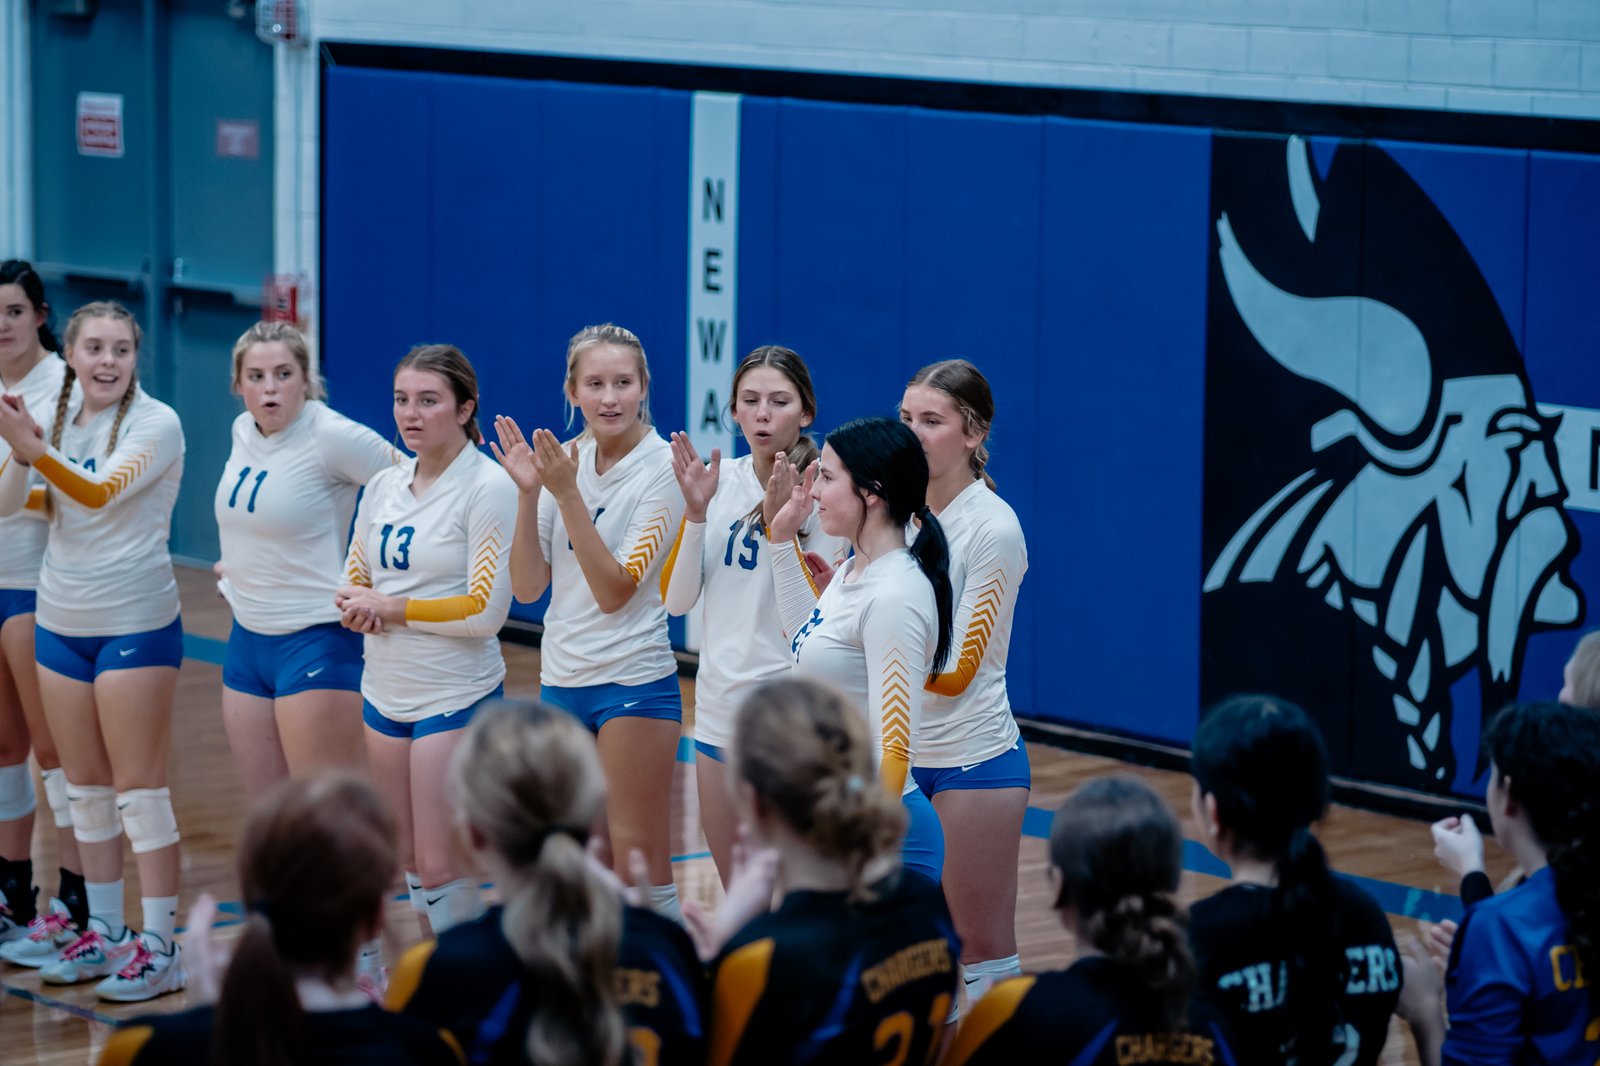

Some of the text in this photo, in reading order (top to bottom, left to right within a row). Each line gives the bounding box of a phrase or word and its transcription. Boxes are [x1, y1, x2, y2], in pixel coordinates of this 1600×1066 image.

[696, 177, 727, 466] NEWA
[228, 466, 268, 513] 11
[380, 523, 415, 571] 13
[724, 519, 766, 570] 15
